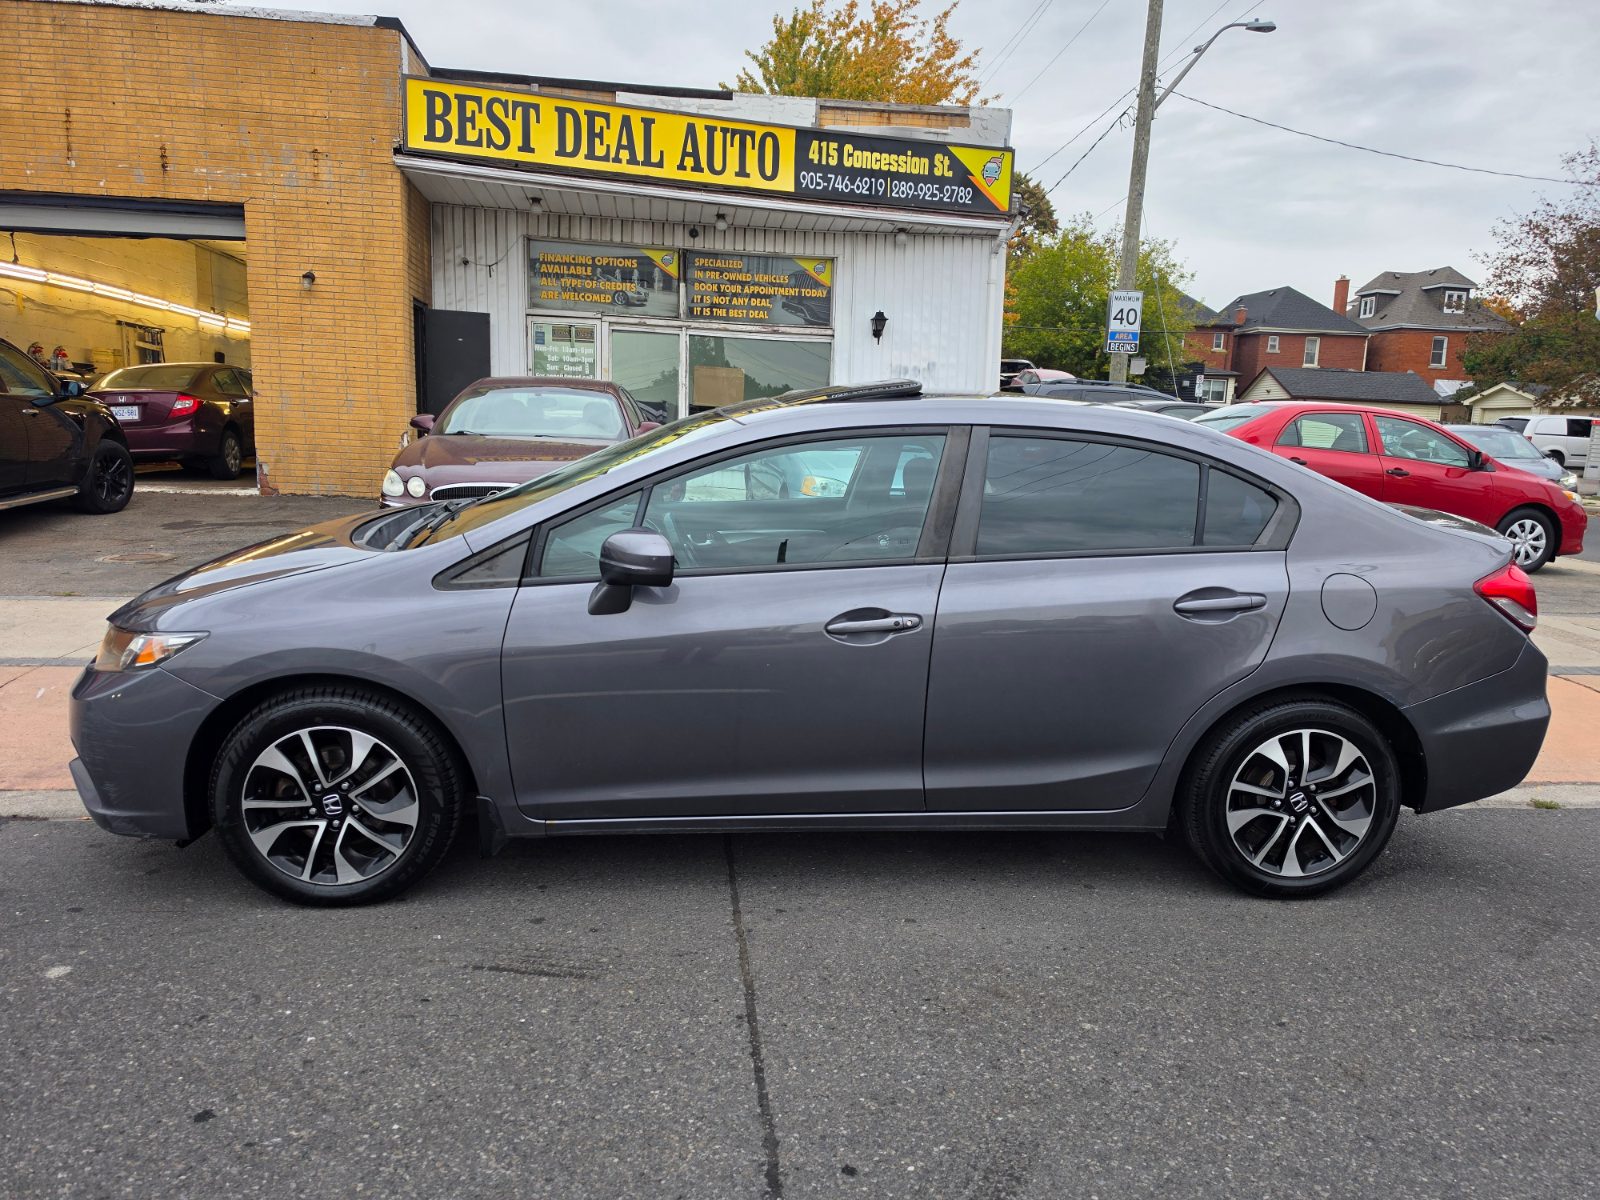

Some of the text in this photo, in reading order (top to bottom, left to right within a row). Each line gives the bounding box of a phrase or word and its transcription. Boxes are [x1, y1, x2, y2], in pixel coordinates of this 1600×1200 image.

[423, 90, 780, 181] BEST DEAL AUTO
[808, 140, 952, 177] 415 Concession St.
[800, 171, 972, 203] 905-746-6219 289-925-2782
[540, 253, 638, 268] FINANCING OPTIONS
[694, 258, 743, 268] SPECIALIZED
[540, 264, 592, 276] AVAILABLE
[706, 272, 752, 282] PRE-OWNED
[754, 274, 788, 284] VEHICLES
[541, 278, 637, 292] ALL TYPE OF CREDITS
[694, 283, 827, 298] BOOK YOUR APPOINTMENT TODAY
[541, 290, 612, 303] ARE WELCOMED
[713, 296, 730, 304] NOT
[732, 298, 748, 306] ANY
[751, 298, 772, 308] DEAL,
[694, 307, 768, 319] IT IS THE BEST DEAL
[1113, 308, 1137, 325] 40
[1111, 343, 1135, 351] BEGINS
[564, 364, 582, 372] Closed
